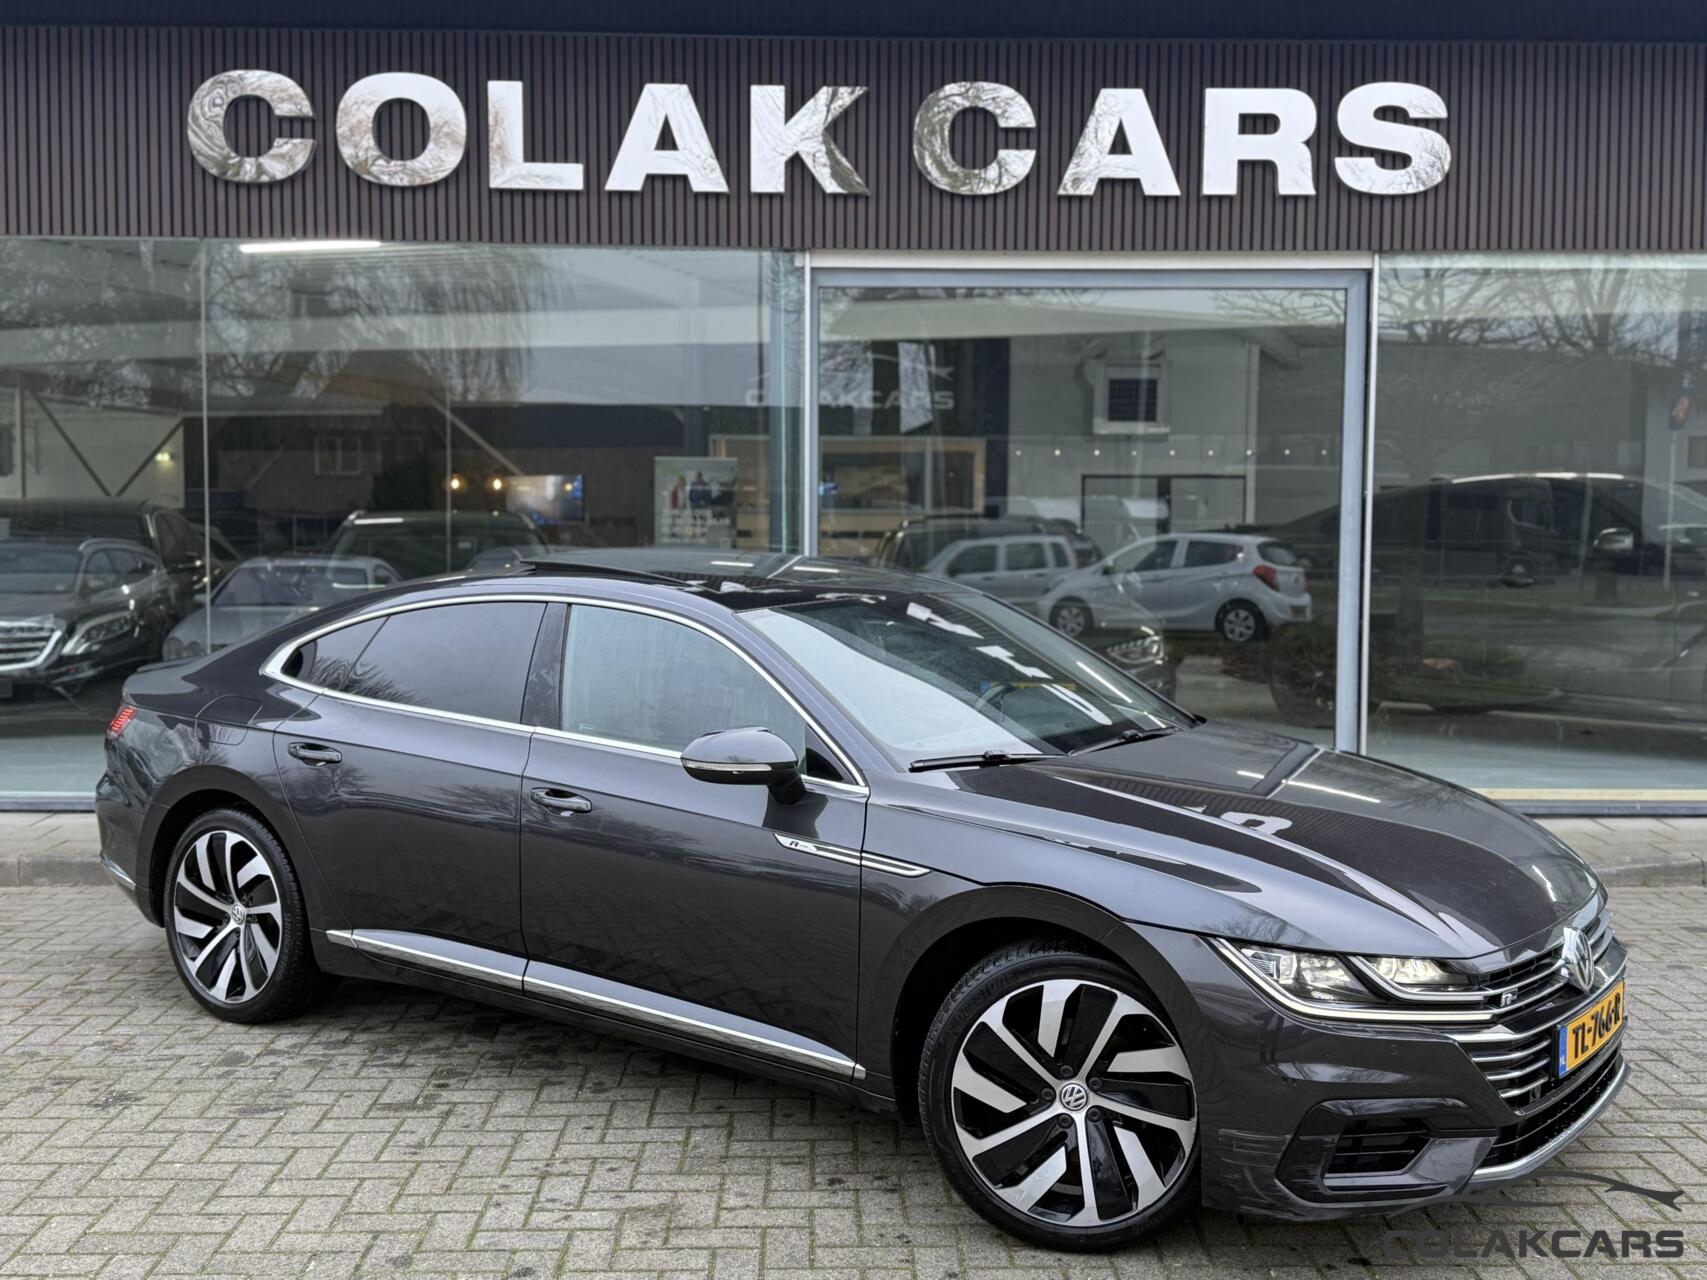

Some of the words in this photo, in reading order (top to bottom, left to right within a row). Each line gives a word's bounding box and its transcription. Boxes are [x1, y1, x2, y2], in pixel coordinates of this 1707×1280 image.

[187, 69, 870, 196] COLAK
[913, 81, 1452, 198] CARS
[744, 388, 955, 410] CAKCARS
[1572, 992, 1621, 1059] TL-766-R
